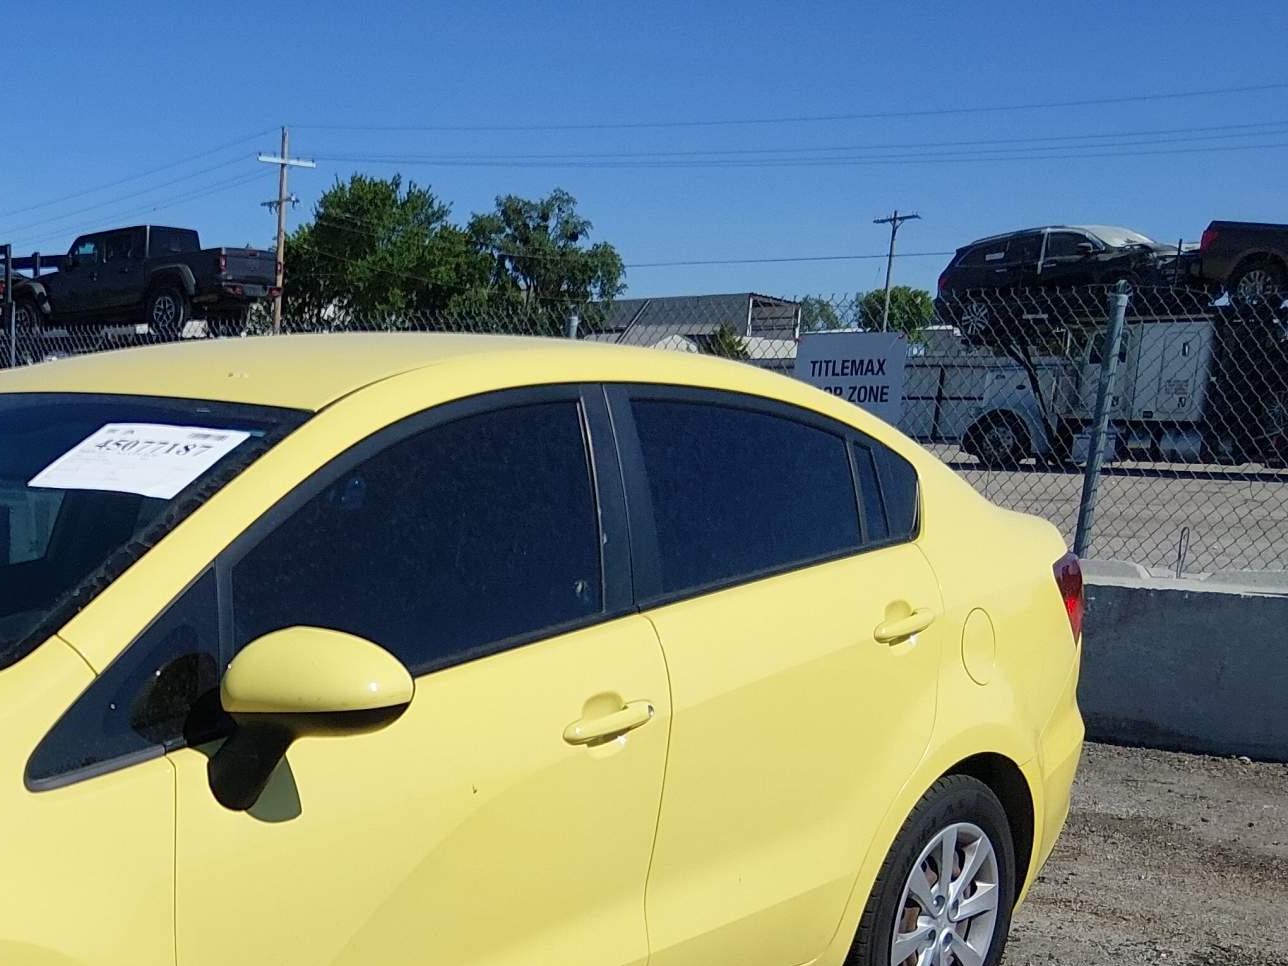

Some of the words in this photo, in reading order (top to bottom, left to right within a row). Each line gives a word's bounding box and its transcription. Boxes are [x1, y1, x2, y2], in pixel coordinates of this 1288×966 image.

[810, 358, 887, 377] TITLEMAX
[848, 385, 890, 403] ZONE
[95, 439, 213, 457] 45077187
